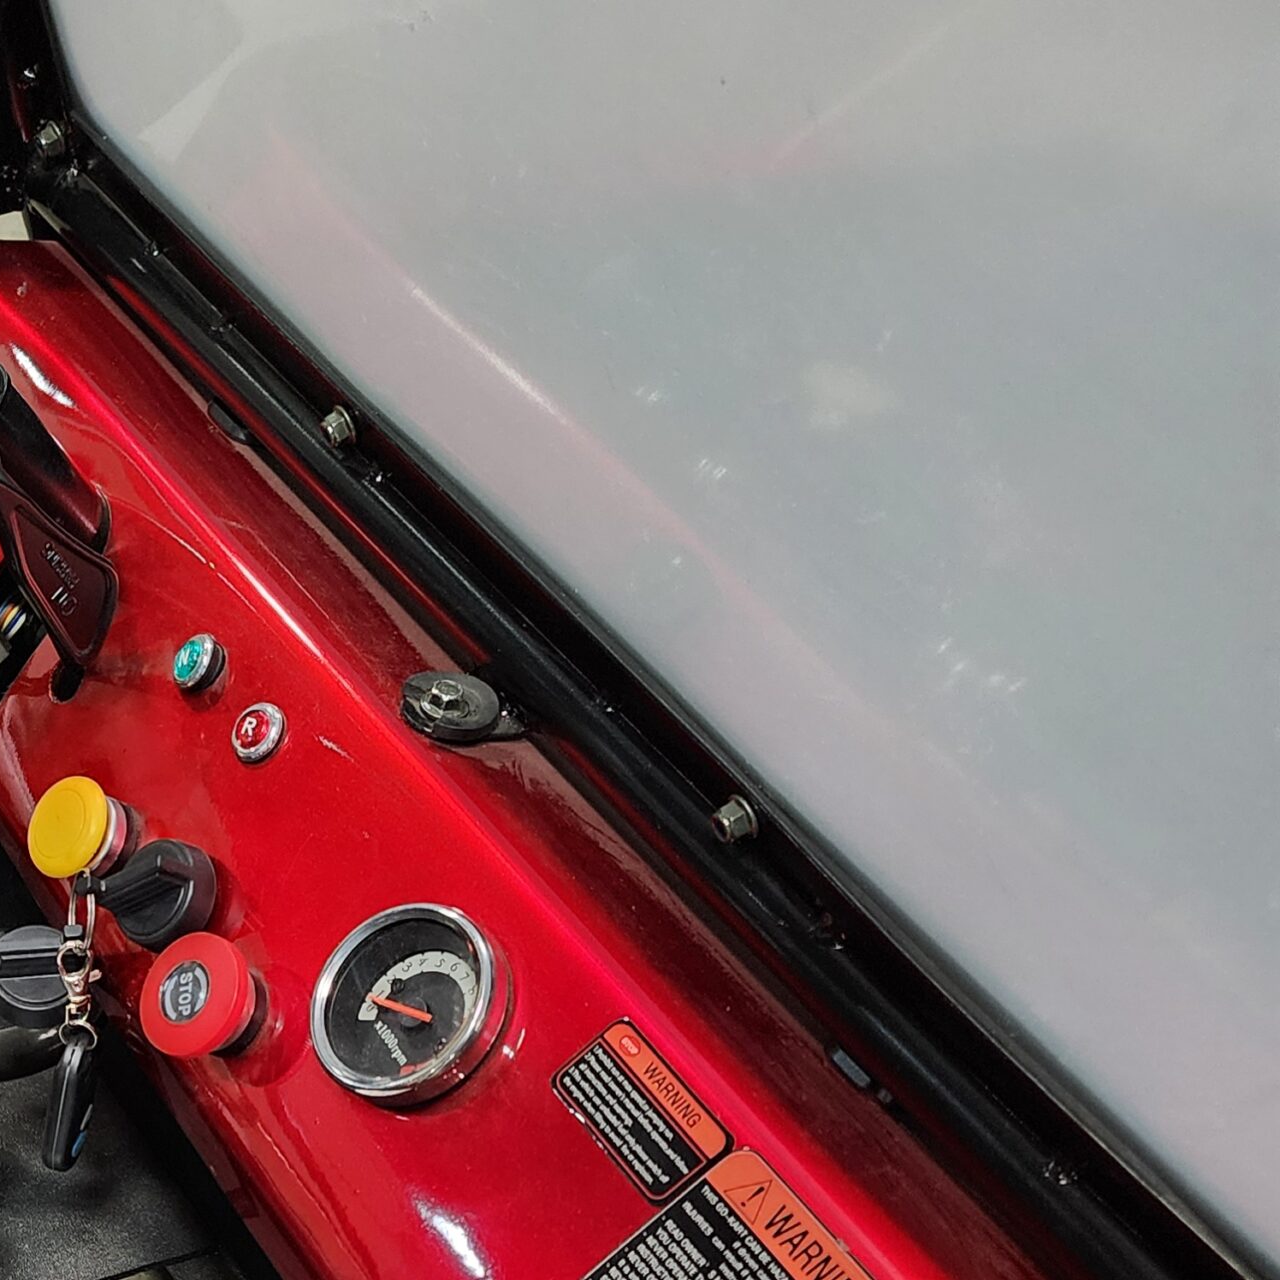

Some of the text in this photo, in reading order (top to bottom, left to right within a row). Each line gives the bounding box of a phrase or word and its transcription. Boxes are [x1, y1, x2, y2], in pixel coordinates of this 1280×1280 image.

[240, 716, 257, 737] R
[402, 961, 413, 972] 3
[435, 958, 446, 968] 5
[450, 961, 460, 972] 6
[460, 973, 470, 981] 7
[175, 971, 194, 1017] STOP
[373, 1020, 408, 1067] x1000rpm
[642, 1061, 702, 1129] WARNING
